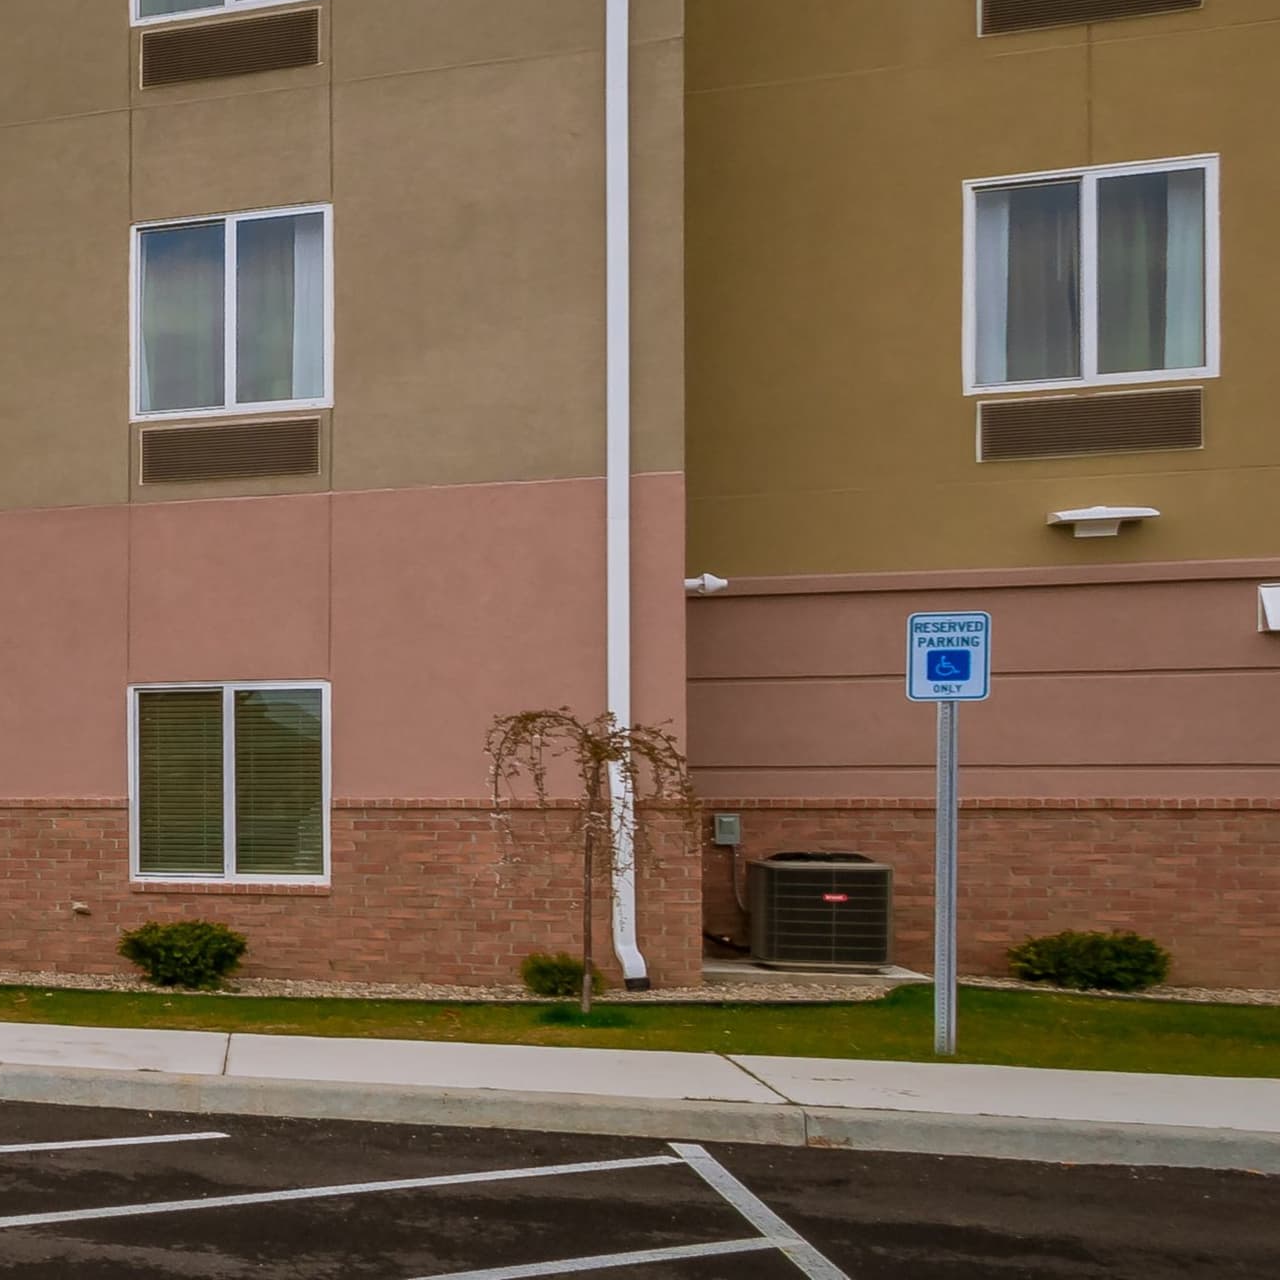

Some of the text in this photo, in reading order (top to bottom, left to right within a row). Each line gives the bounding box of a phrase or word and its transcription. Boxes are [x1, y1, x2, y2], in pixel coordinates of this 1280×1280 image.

[914, 621, 984, 633] RESERVED
[917, 635, 980, 648] PARKING
[933, 684, 963, 693] ONLY
